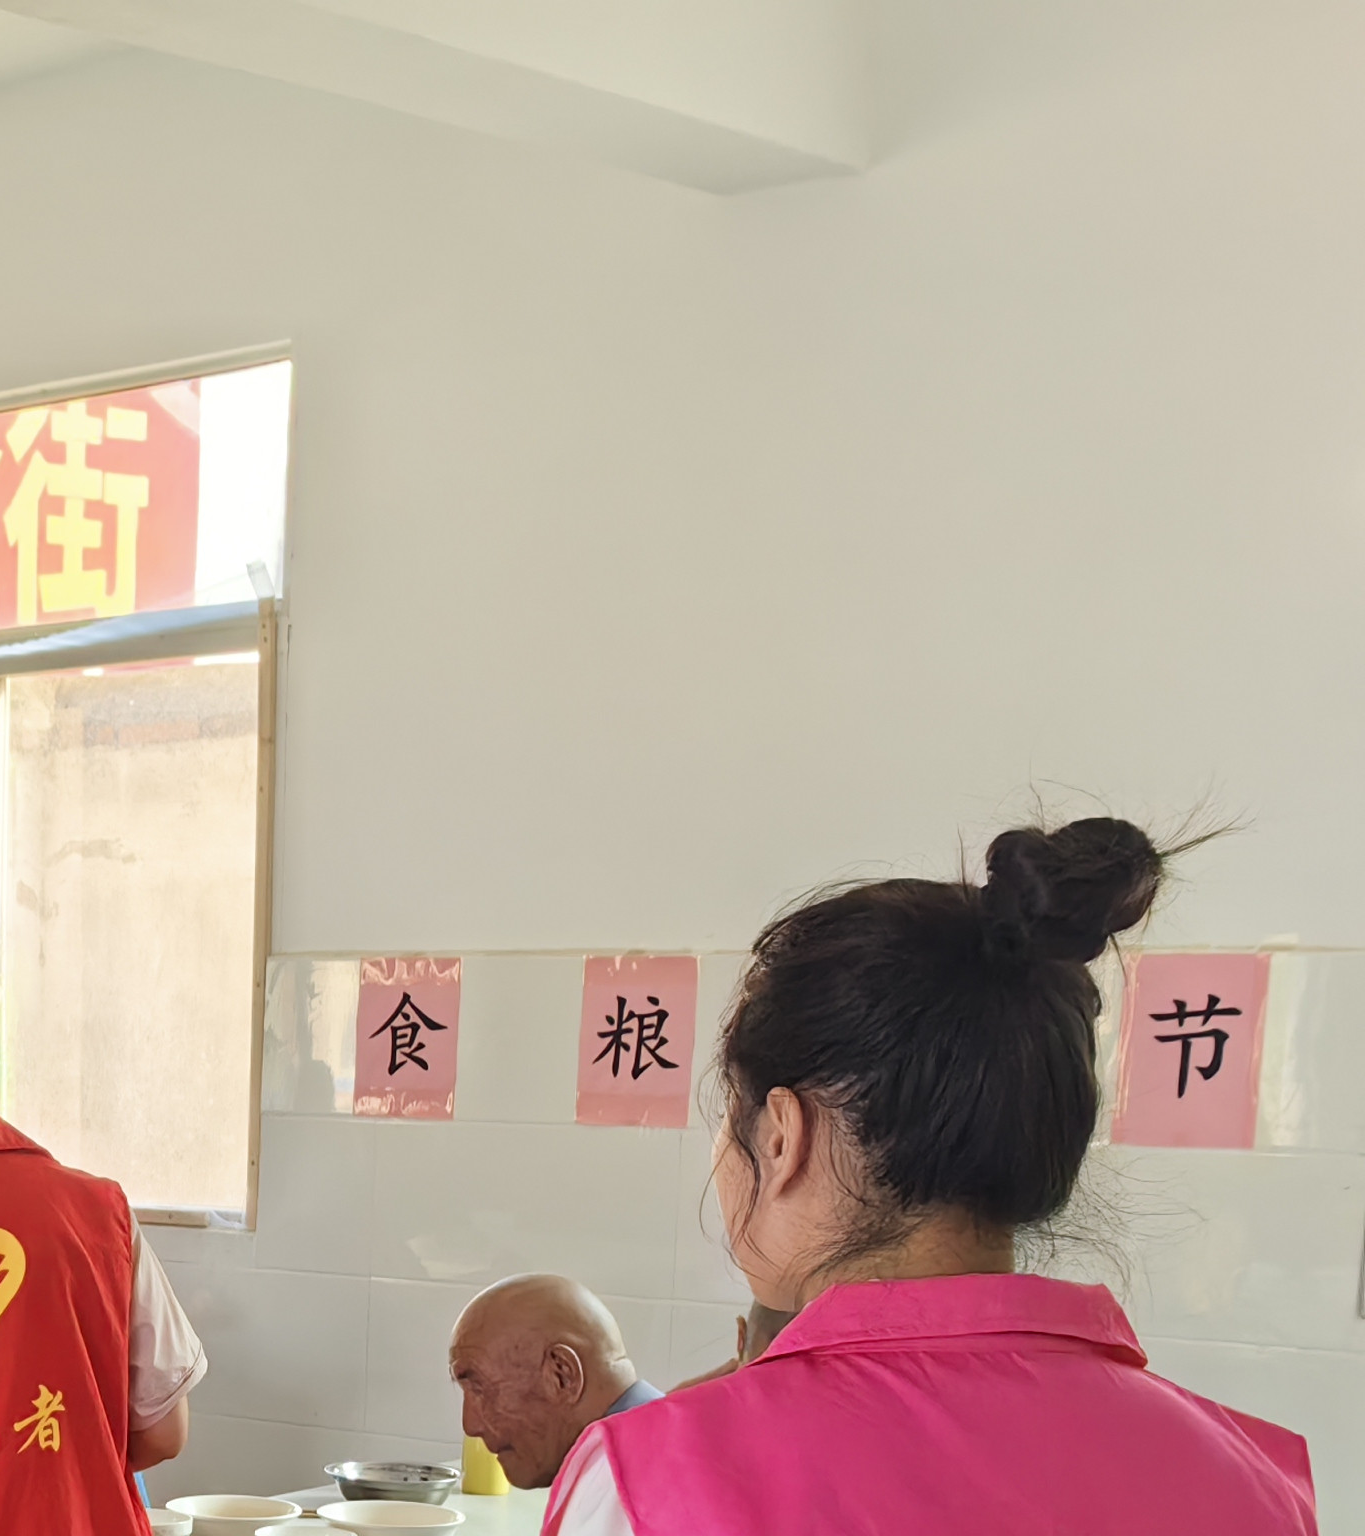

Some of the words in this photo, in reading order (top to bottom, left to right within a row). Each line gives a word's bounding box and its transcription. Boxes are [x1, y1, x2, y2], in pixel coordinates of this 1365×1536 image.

[368, 991, 449, 1076] 食
[591, 995, 681, 1080] 粮
[1149, 993, 1244, 1099] 节
